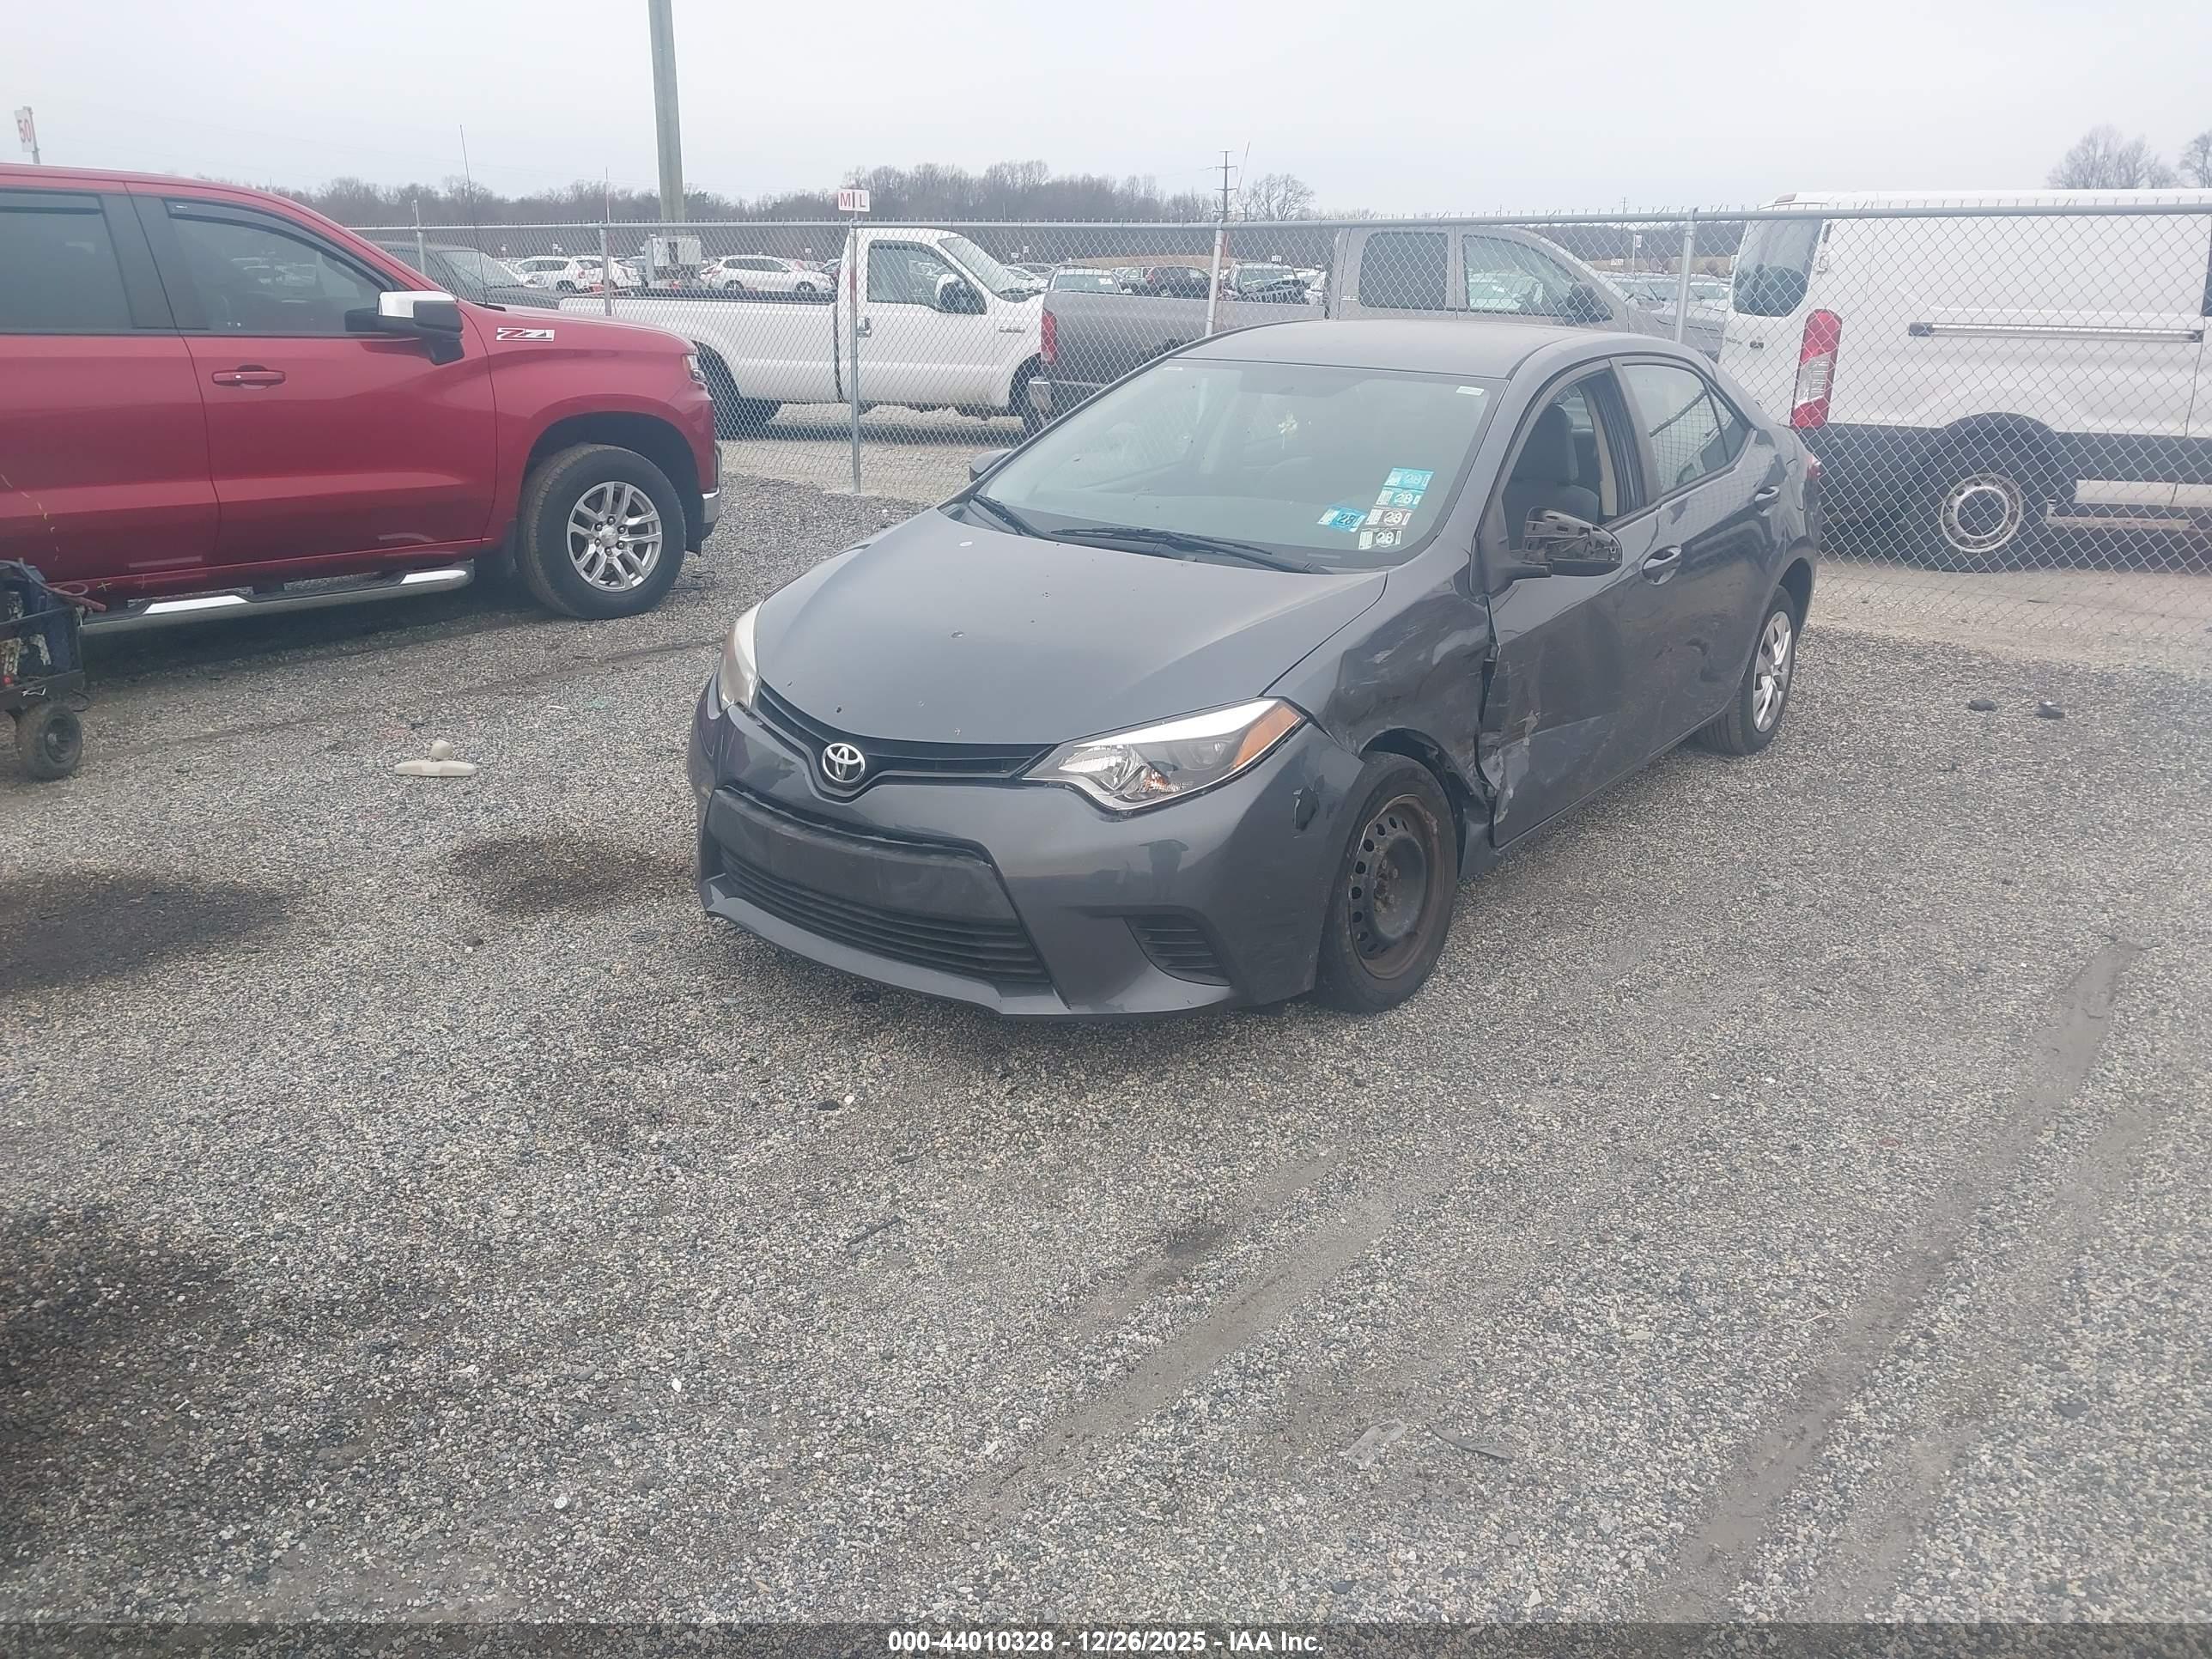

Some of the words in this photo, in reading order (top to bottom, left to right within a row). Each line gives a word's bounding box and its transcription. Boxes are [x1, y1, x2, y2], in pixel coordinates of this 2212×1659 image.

[17, 118, 32, 143] 50
[495, 327, 555, 342] Z71
[1337, 513, 1357, 526] 28
